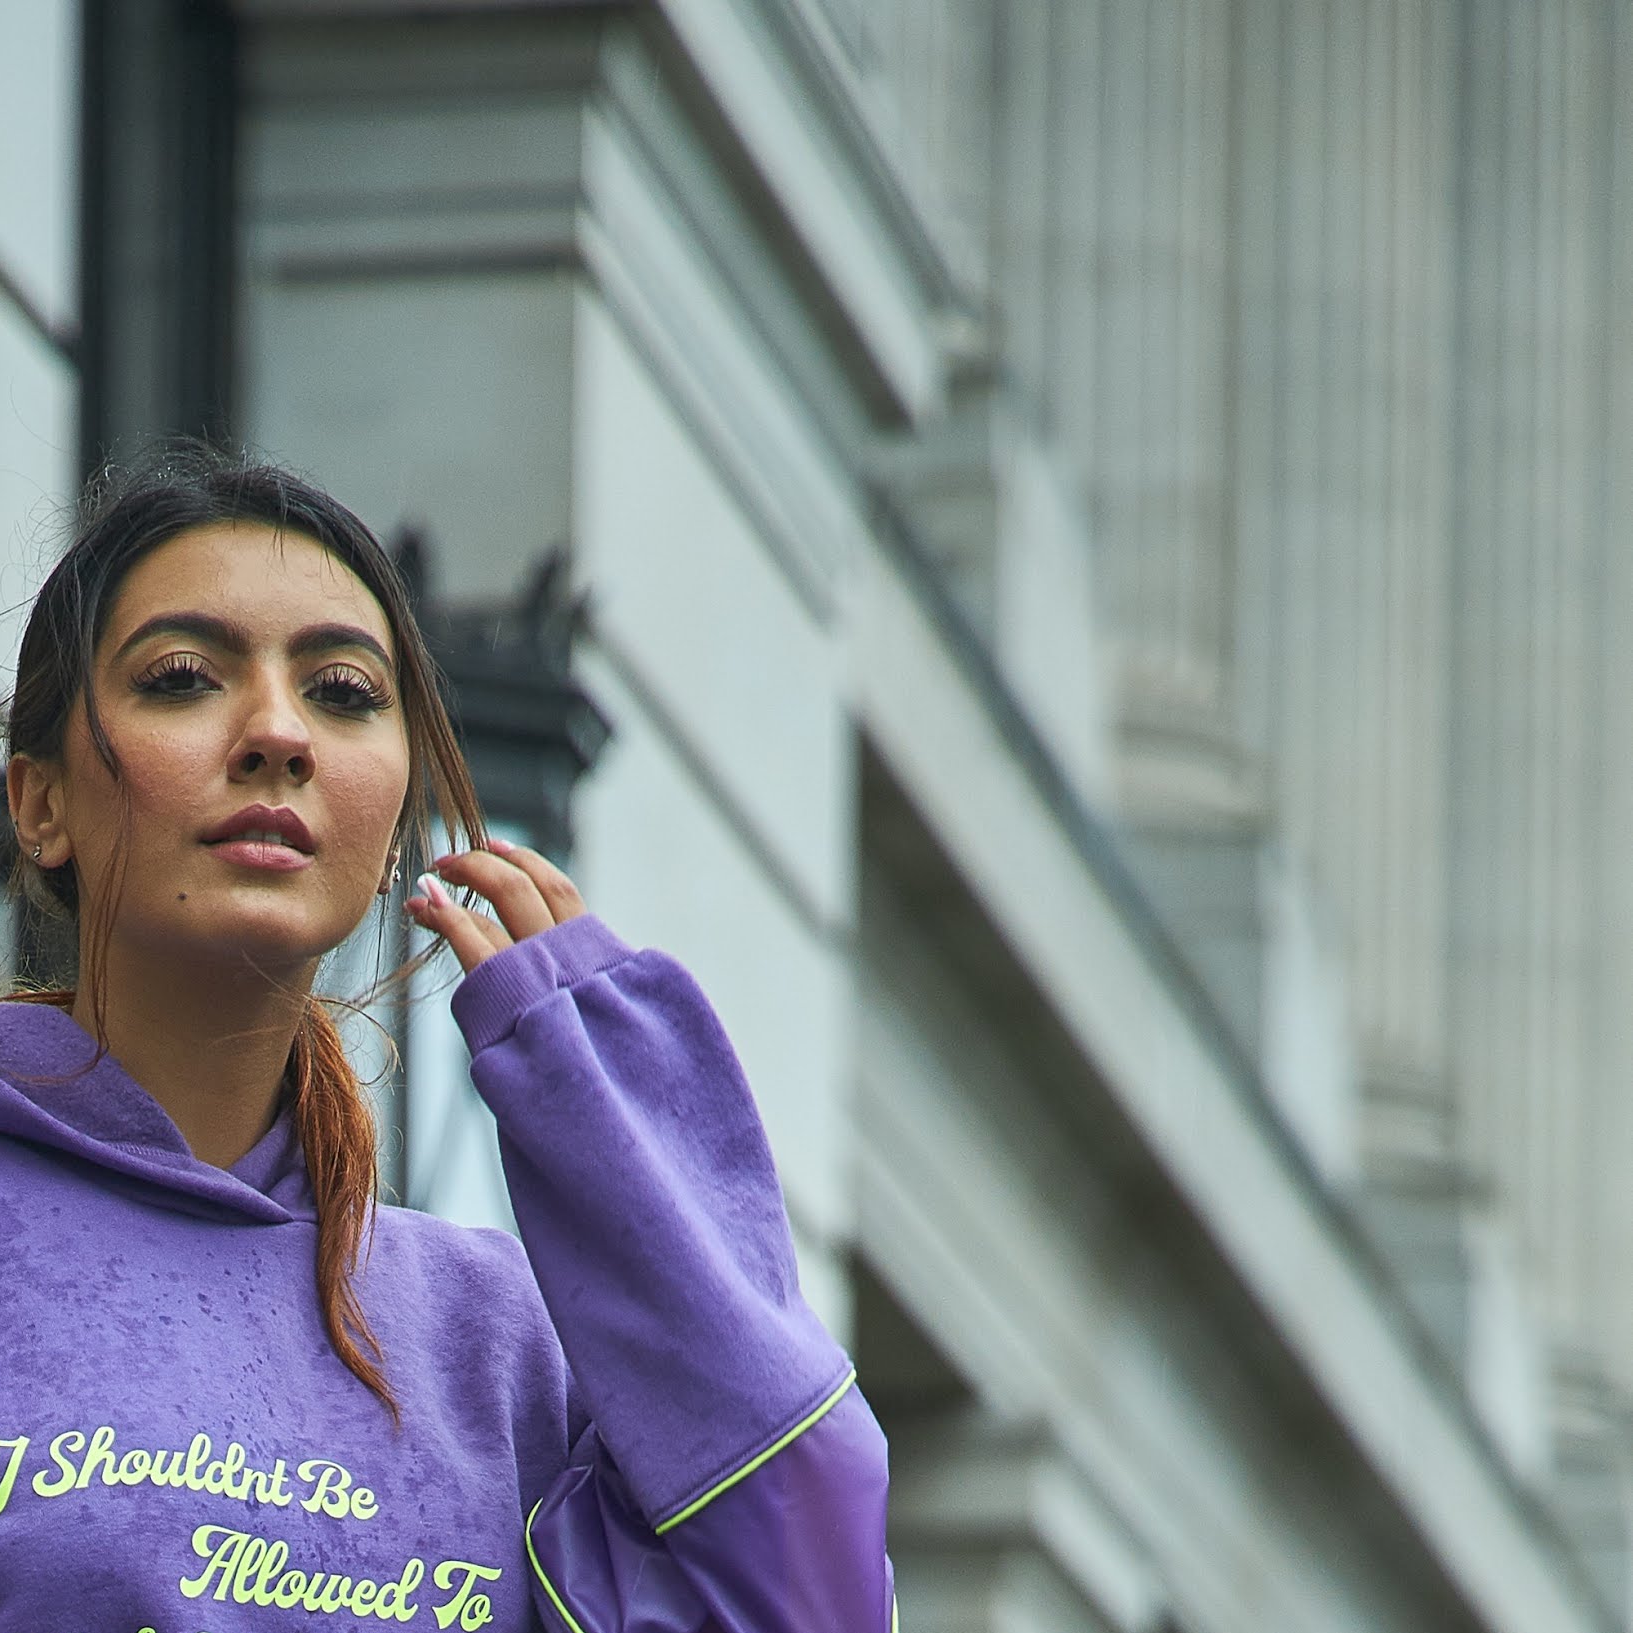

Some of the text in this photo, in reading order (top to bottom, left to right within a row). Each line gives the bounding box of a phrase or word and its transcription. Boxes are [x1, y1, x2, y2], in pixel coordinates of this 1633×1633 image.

[32, 1426, 293, 1506] Shouldnt
[296, 1459, 379, 1520] Be
[180, 1524, 502, 1632] Allowed To
